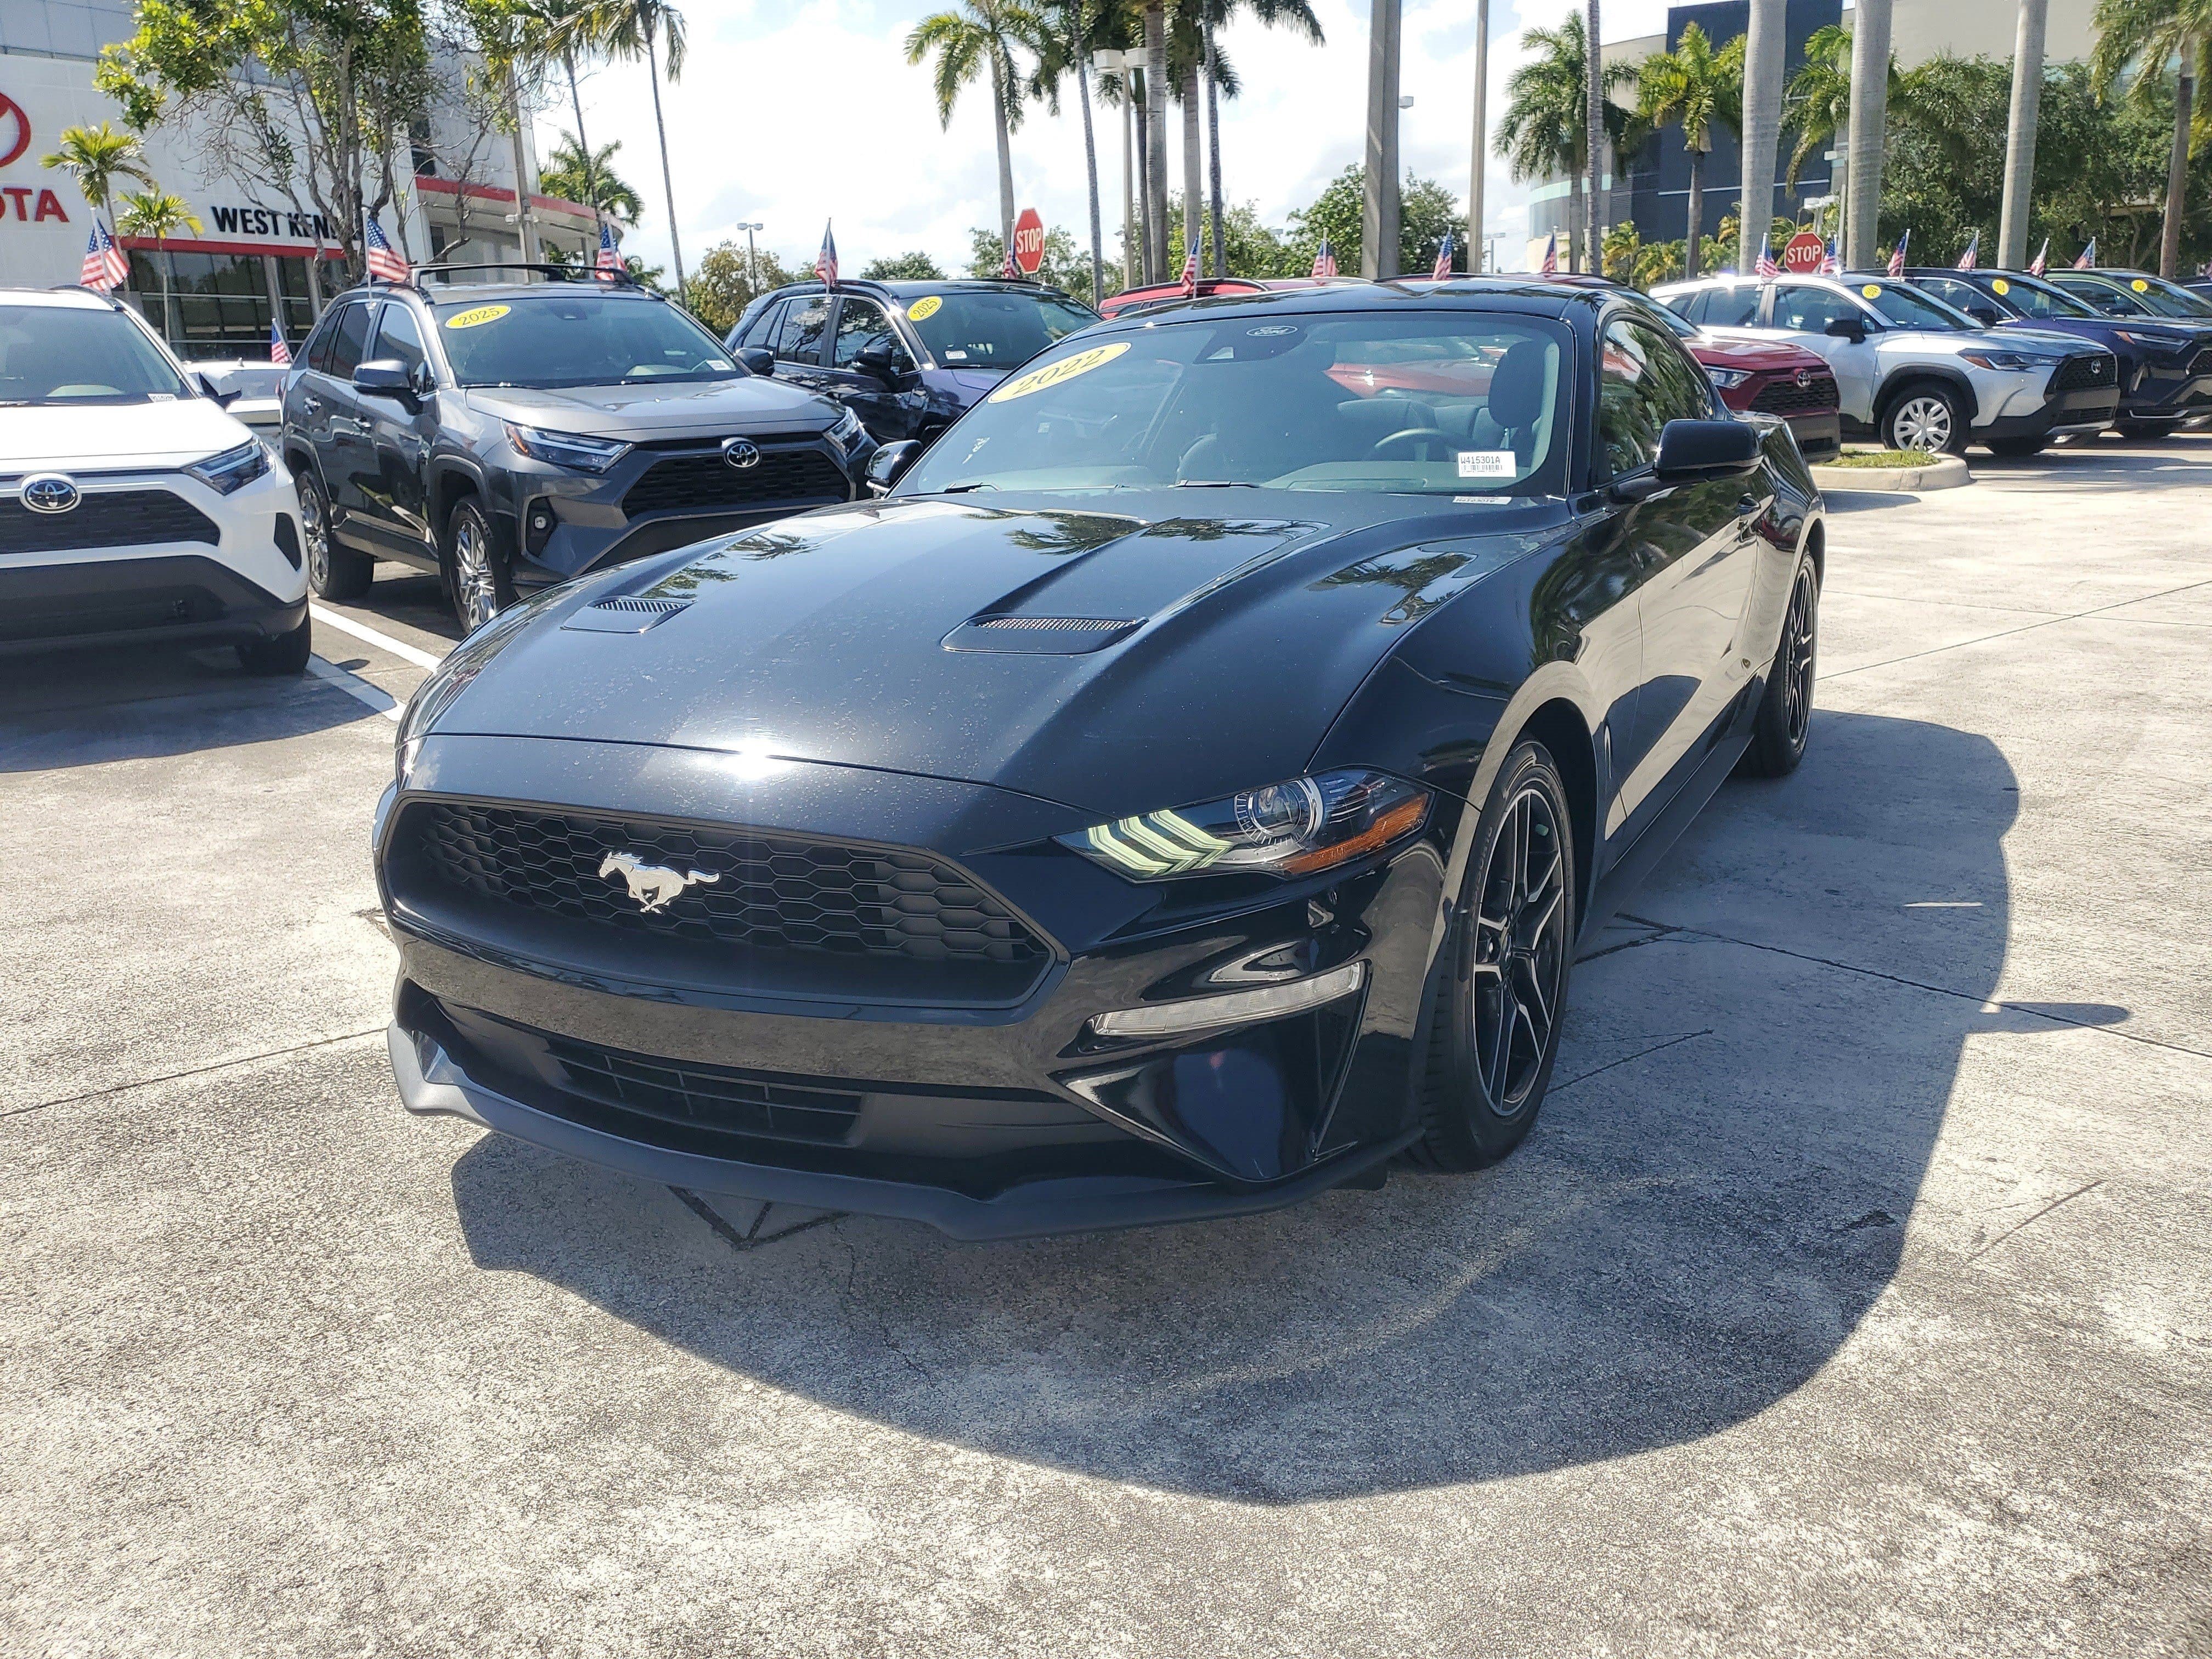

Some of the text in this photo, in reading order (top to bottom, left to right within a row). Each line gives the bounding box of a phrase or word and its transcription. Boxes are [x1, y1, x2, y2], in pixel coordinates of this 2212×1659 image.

[0, 187, 70, 222] TA
[211, 206, 280, 236] WEST
[1016, 228, 1042, 254] STOP
[1787, 245, 1821, 263] STOP
[459, 307, 500, 326] 2025
[913, 299, 938, 318] 2025
[1012, 349, 1105, 396] 2022
[1460, 456, 1500, 464] W415301A
